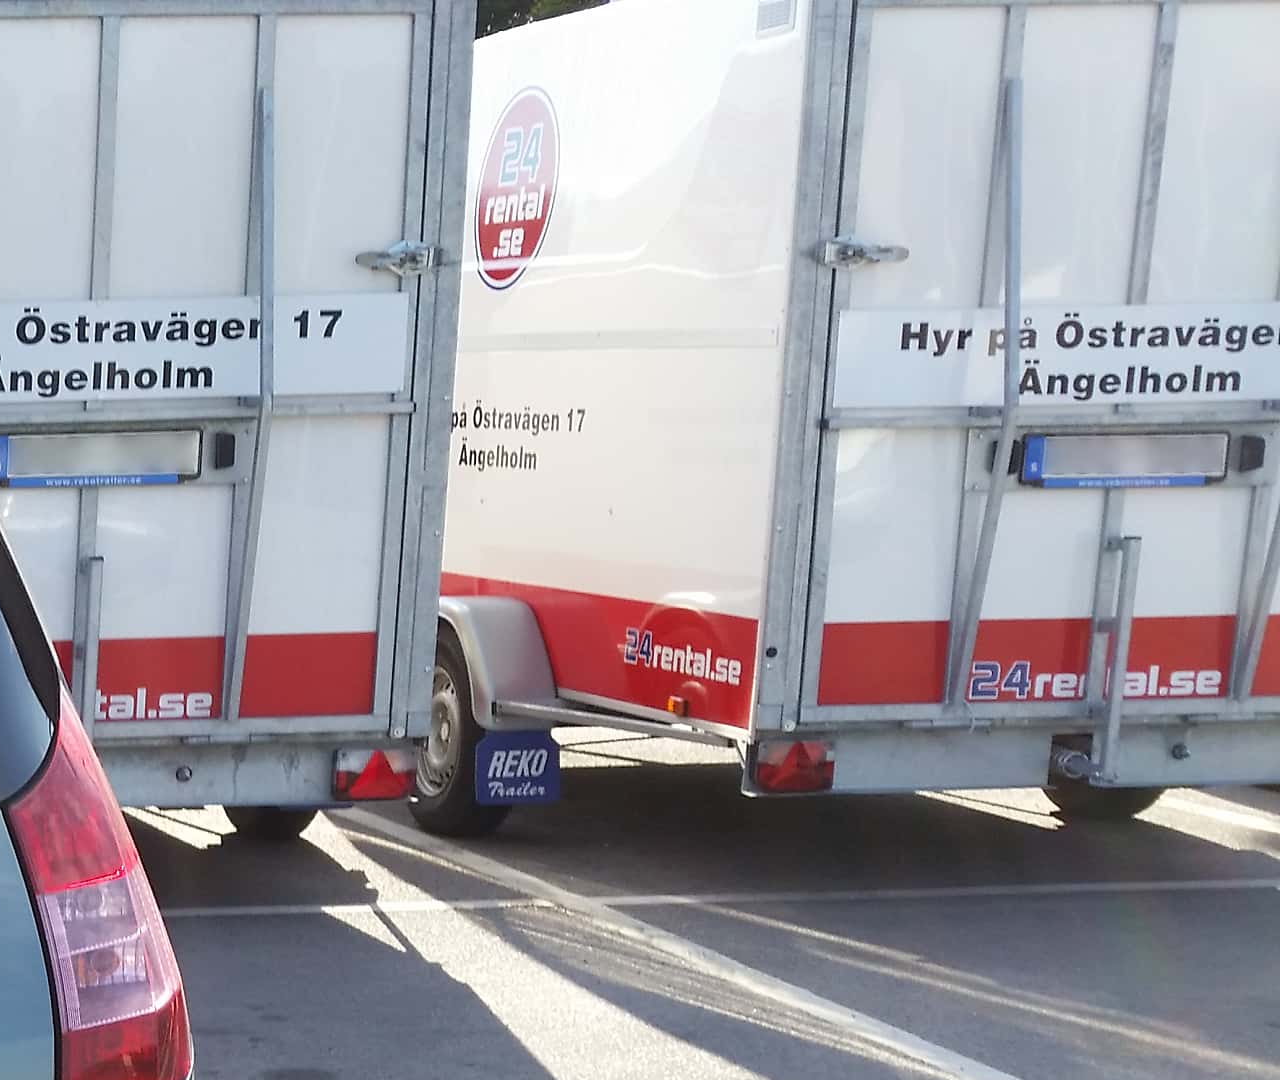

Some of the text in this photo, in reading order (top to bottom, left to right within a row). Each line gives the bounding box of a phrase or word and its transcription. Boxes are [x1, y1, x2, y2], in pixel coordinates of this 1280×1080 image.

[498, 121, 544, 186] 24
[484, 182, 546, 225] rental
[493, 227, 525, 259] .se
[293, 309, 343, 339] 17
[900, 322, 973, 357] Hyr
[1055, 312, 1280, 352] Östraväge
[1018, 359, 1242, 401] Ängelholm
[473, 399, 561, 436] Östravägen
[567, 408, 586, 433] 17
[458, 436, 538, 472] Ängelholm
[623, 626, 742, 687] 24rental.se
[968, 660, 1223, 700] 24real.se
[487, 748, 549, 779] REKO
[487, 780, 546, 798] Trailer
